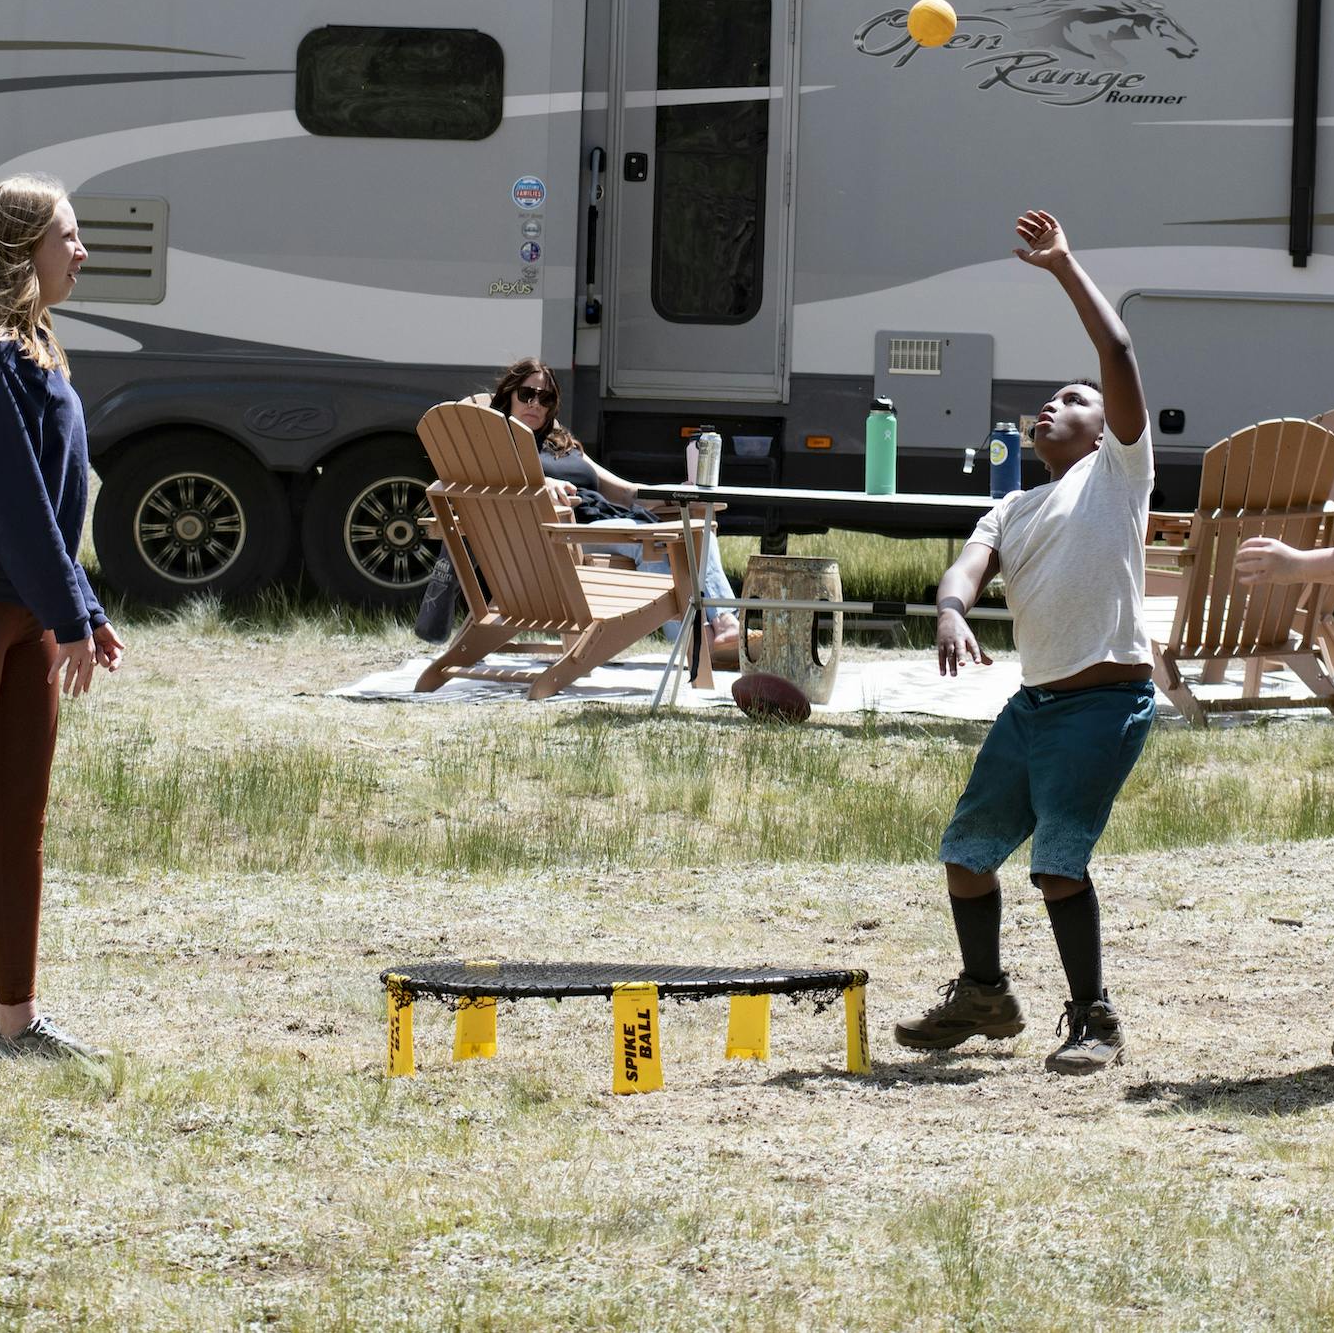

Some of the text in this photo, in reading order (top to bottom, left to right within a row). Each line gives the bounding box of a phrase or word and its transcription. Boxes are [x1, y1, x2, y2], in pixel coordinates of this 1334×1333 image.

[964, 51, 1146, 107] Range
[1105, 90, 1187, 105] Roamer
[489, 278, 531, 298] plexus
[623, 1023, 638, 1082] SPIKE
[637, 1008, 652, 1059] BALL
